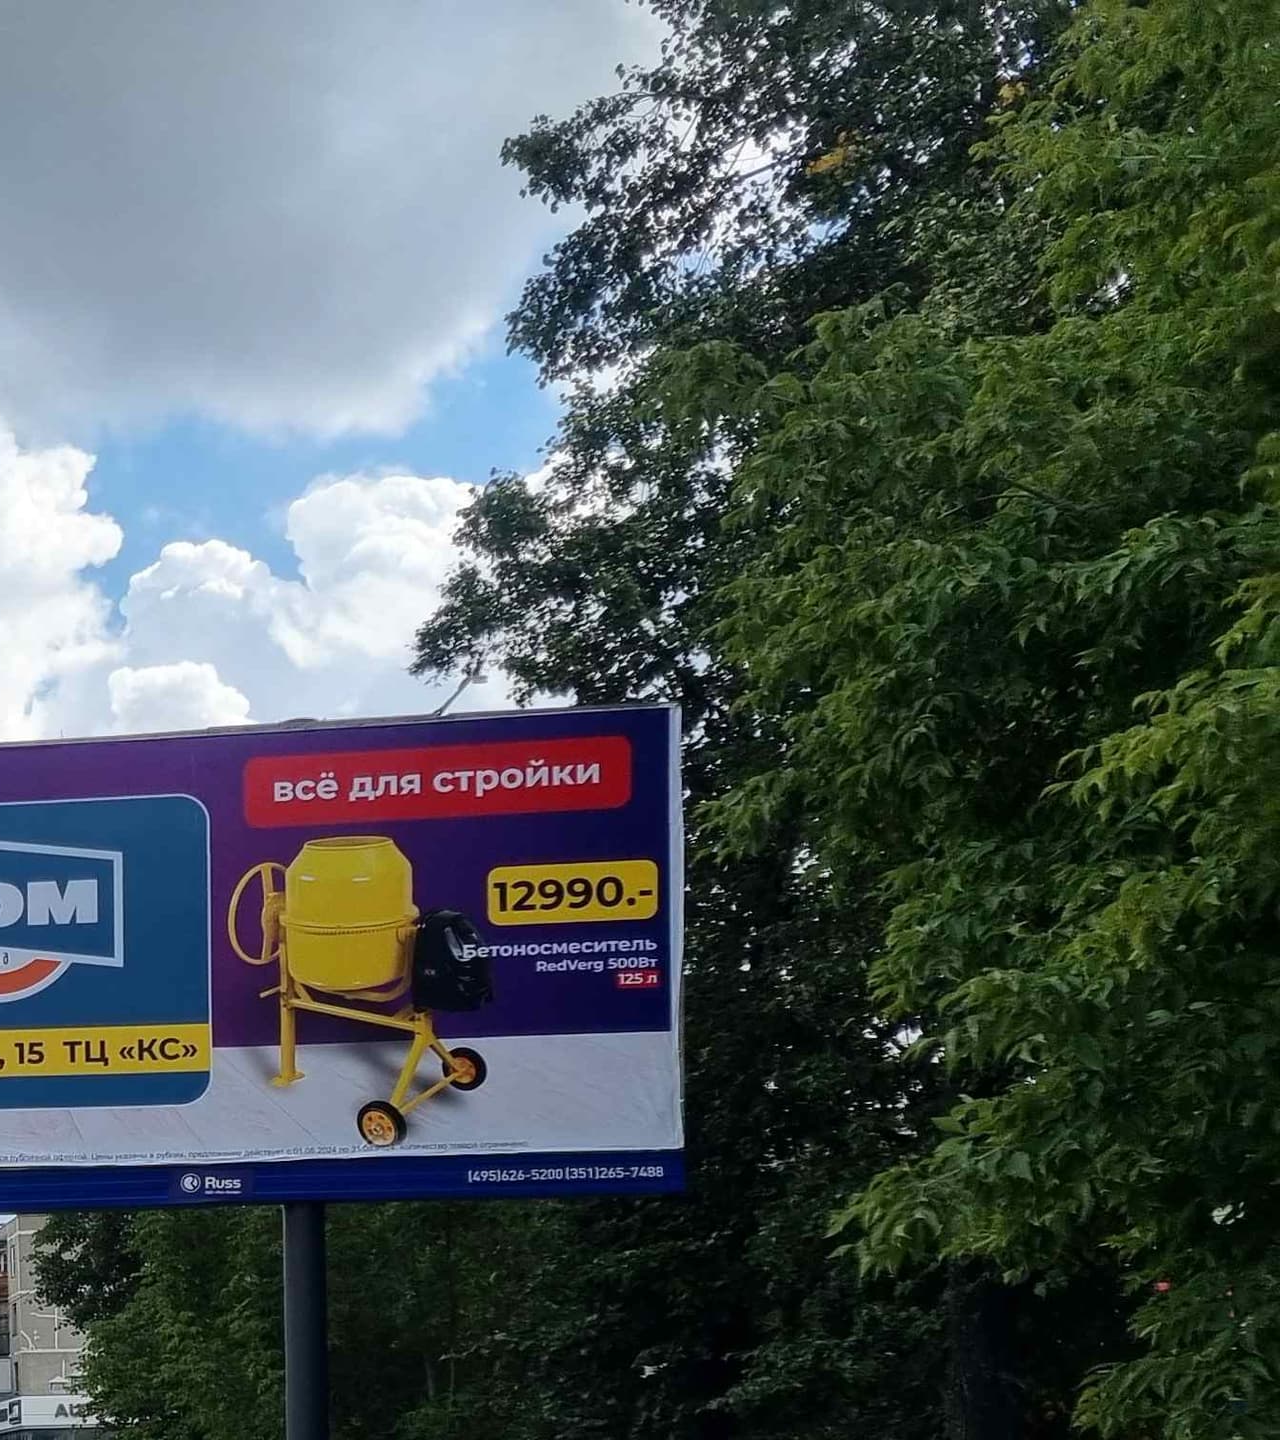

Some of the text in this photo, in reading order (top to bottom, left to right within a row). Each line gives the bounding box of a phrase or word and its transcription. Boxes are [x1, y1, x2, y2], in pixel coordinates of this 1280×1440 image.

[273, 760, 602, 802] всё для стройки
[493, 876, 653, 912] 12990.-
[462, 938, 658, 959] Бетоносмеситель
[536, 957, 658, 973] RedVerg 500Вт
[617, 973, 658, 985] 125 л
[14, 1042, 45, 1065] 15
[63, 1040, 109, 1065] ТЦ
[119, 1038, 198, 1061] «КС»
[204, 1175, 242, 1190] Russ
